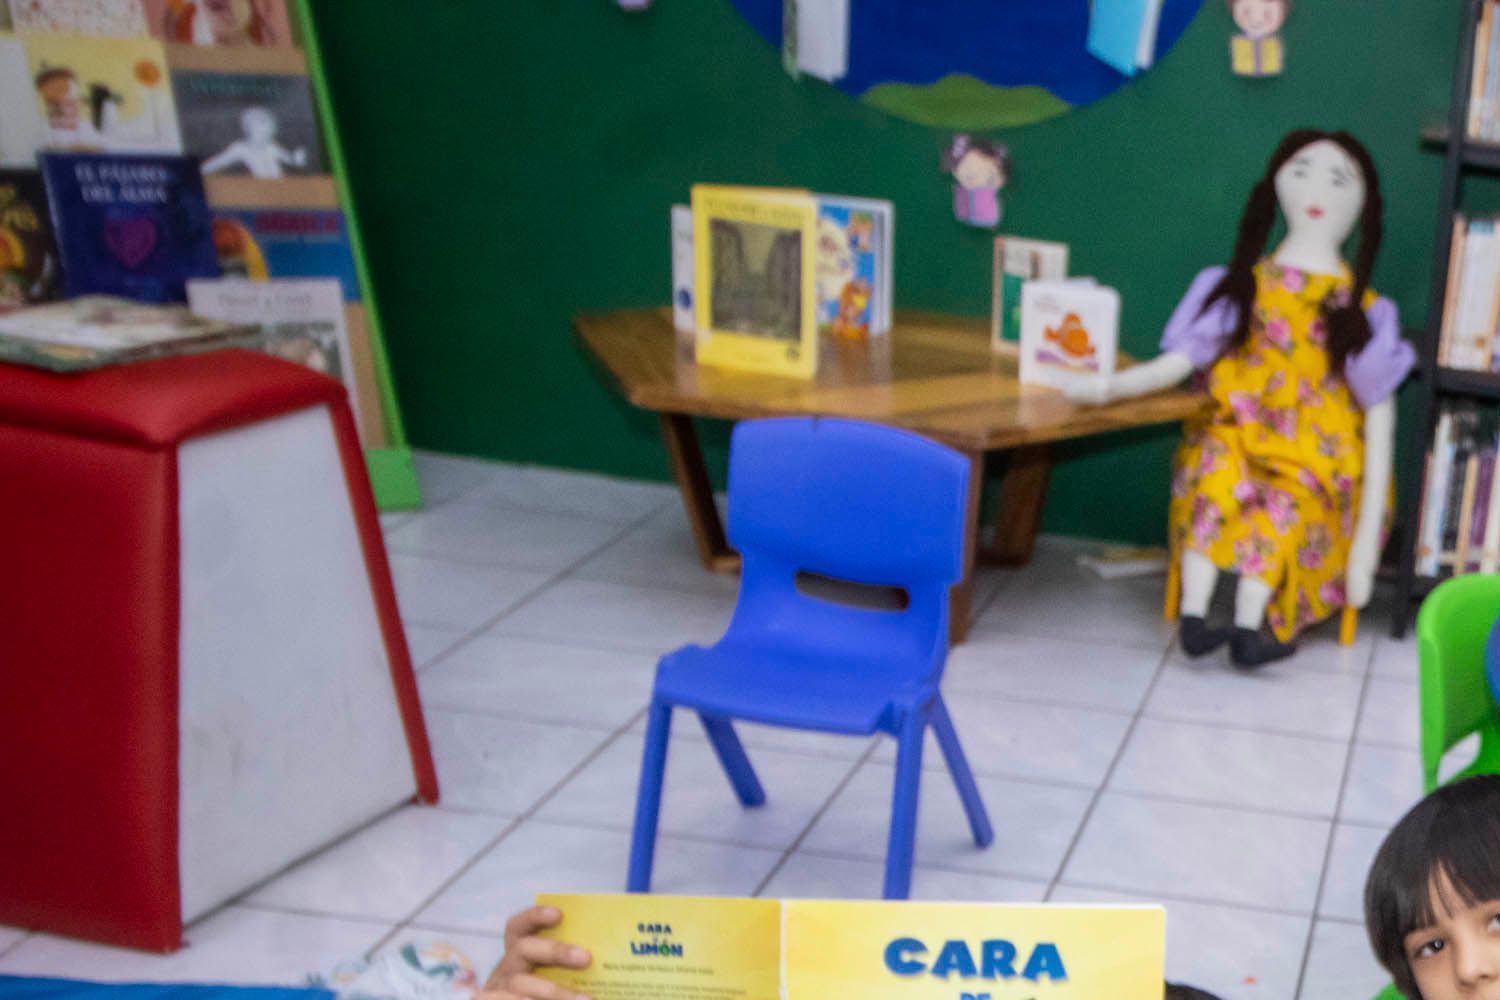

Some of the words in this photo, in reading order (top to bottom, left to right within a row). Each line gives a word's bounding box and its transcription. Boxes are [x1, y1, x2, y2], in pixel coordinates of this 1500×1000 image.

[637, 922, 672, 935] CARA
[630, 938, 684, 957] LIMÓN
[884, 937, 1068, 981] CARA
